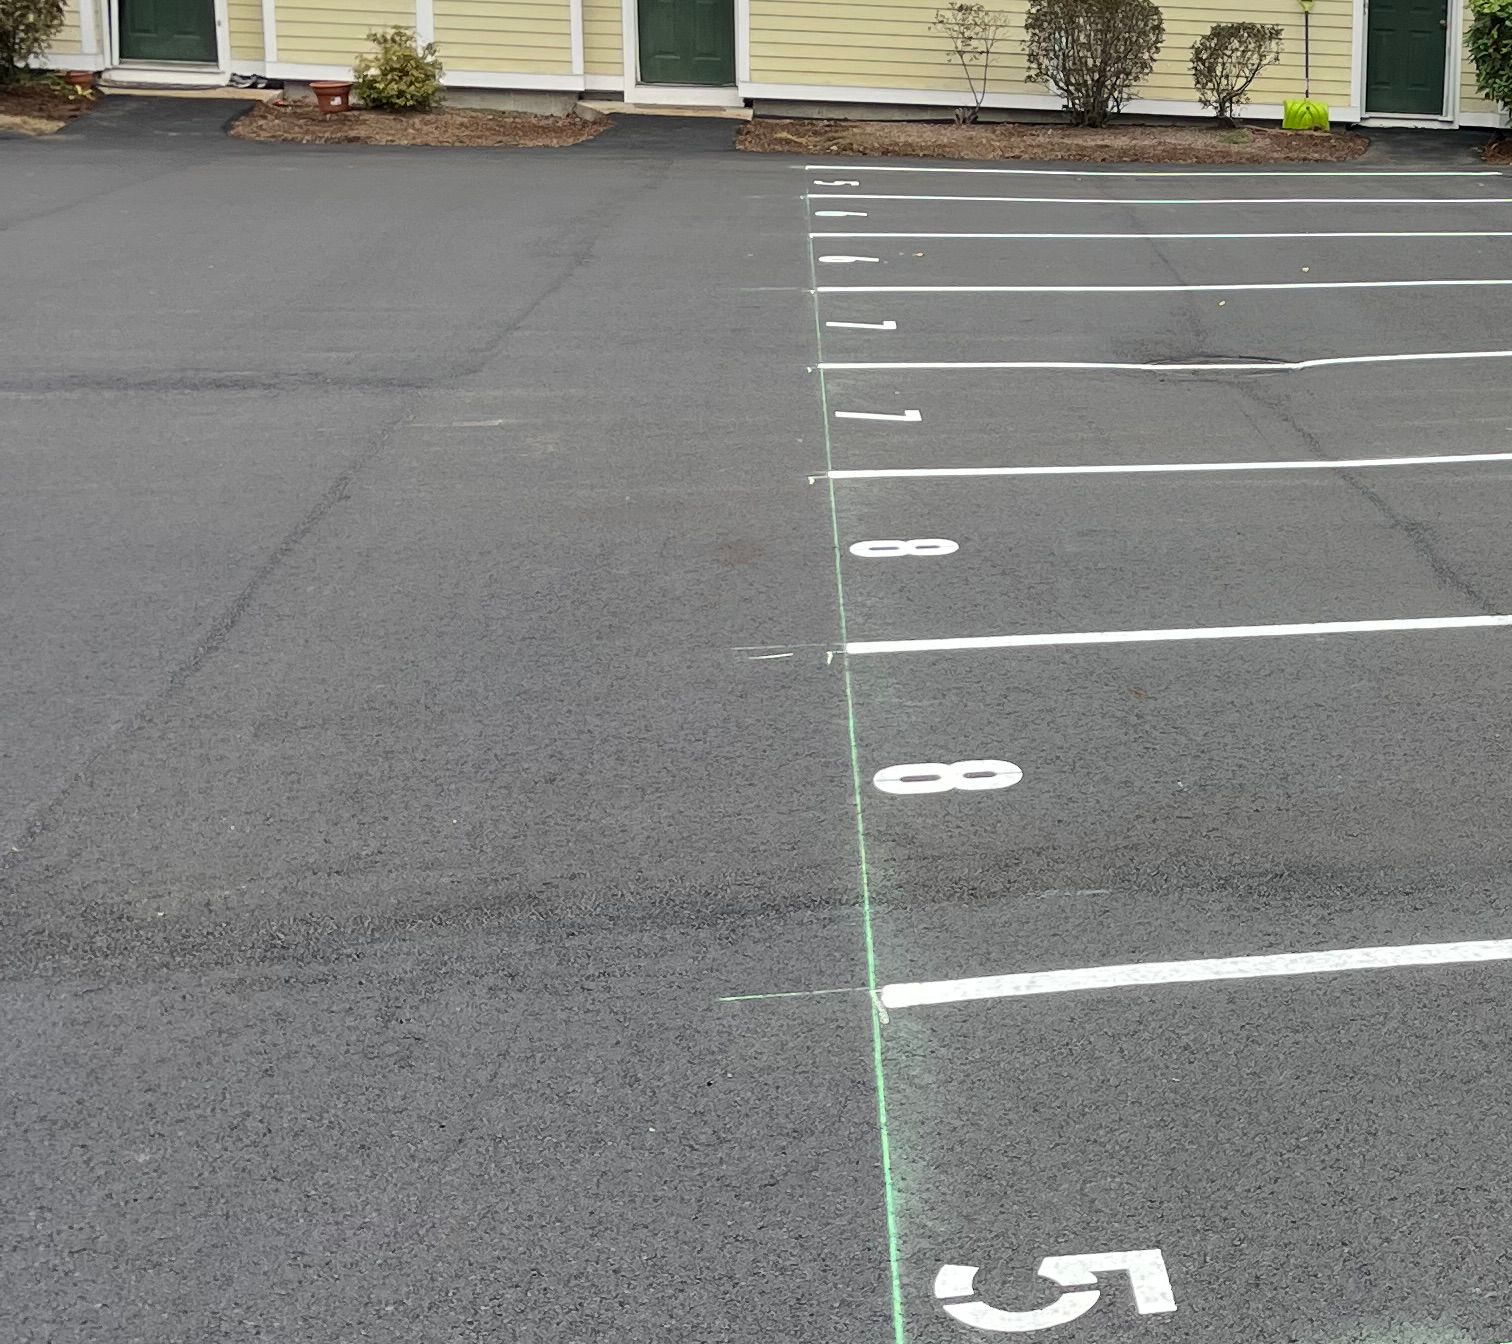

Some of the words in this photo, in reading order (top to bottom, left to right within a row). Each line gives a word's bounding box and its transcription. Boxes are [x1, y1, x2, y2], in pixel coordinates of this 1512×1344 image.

[850, 538, 960, 557] 8
[873, 759, 1024, 795] 8
[934, 1248, 1178, 1332] 5
